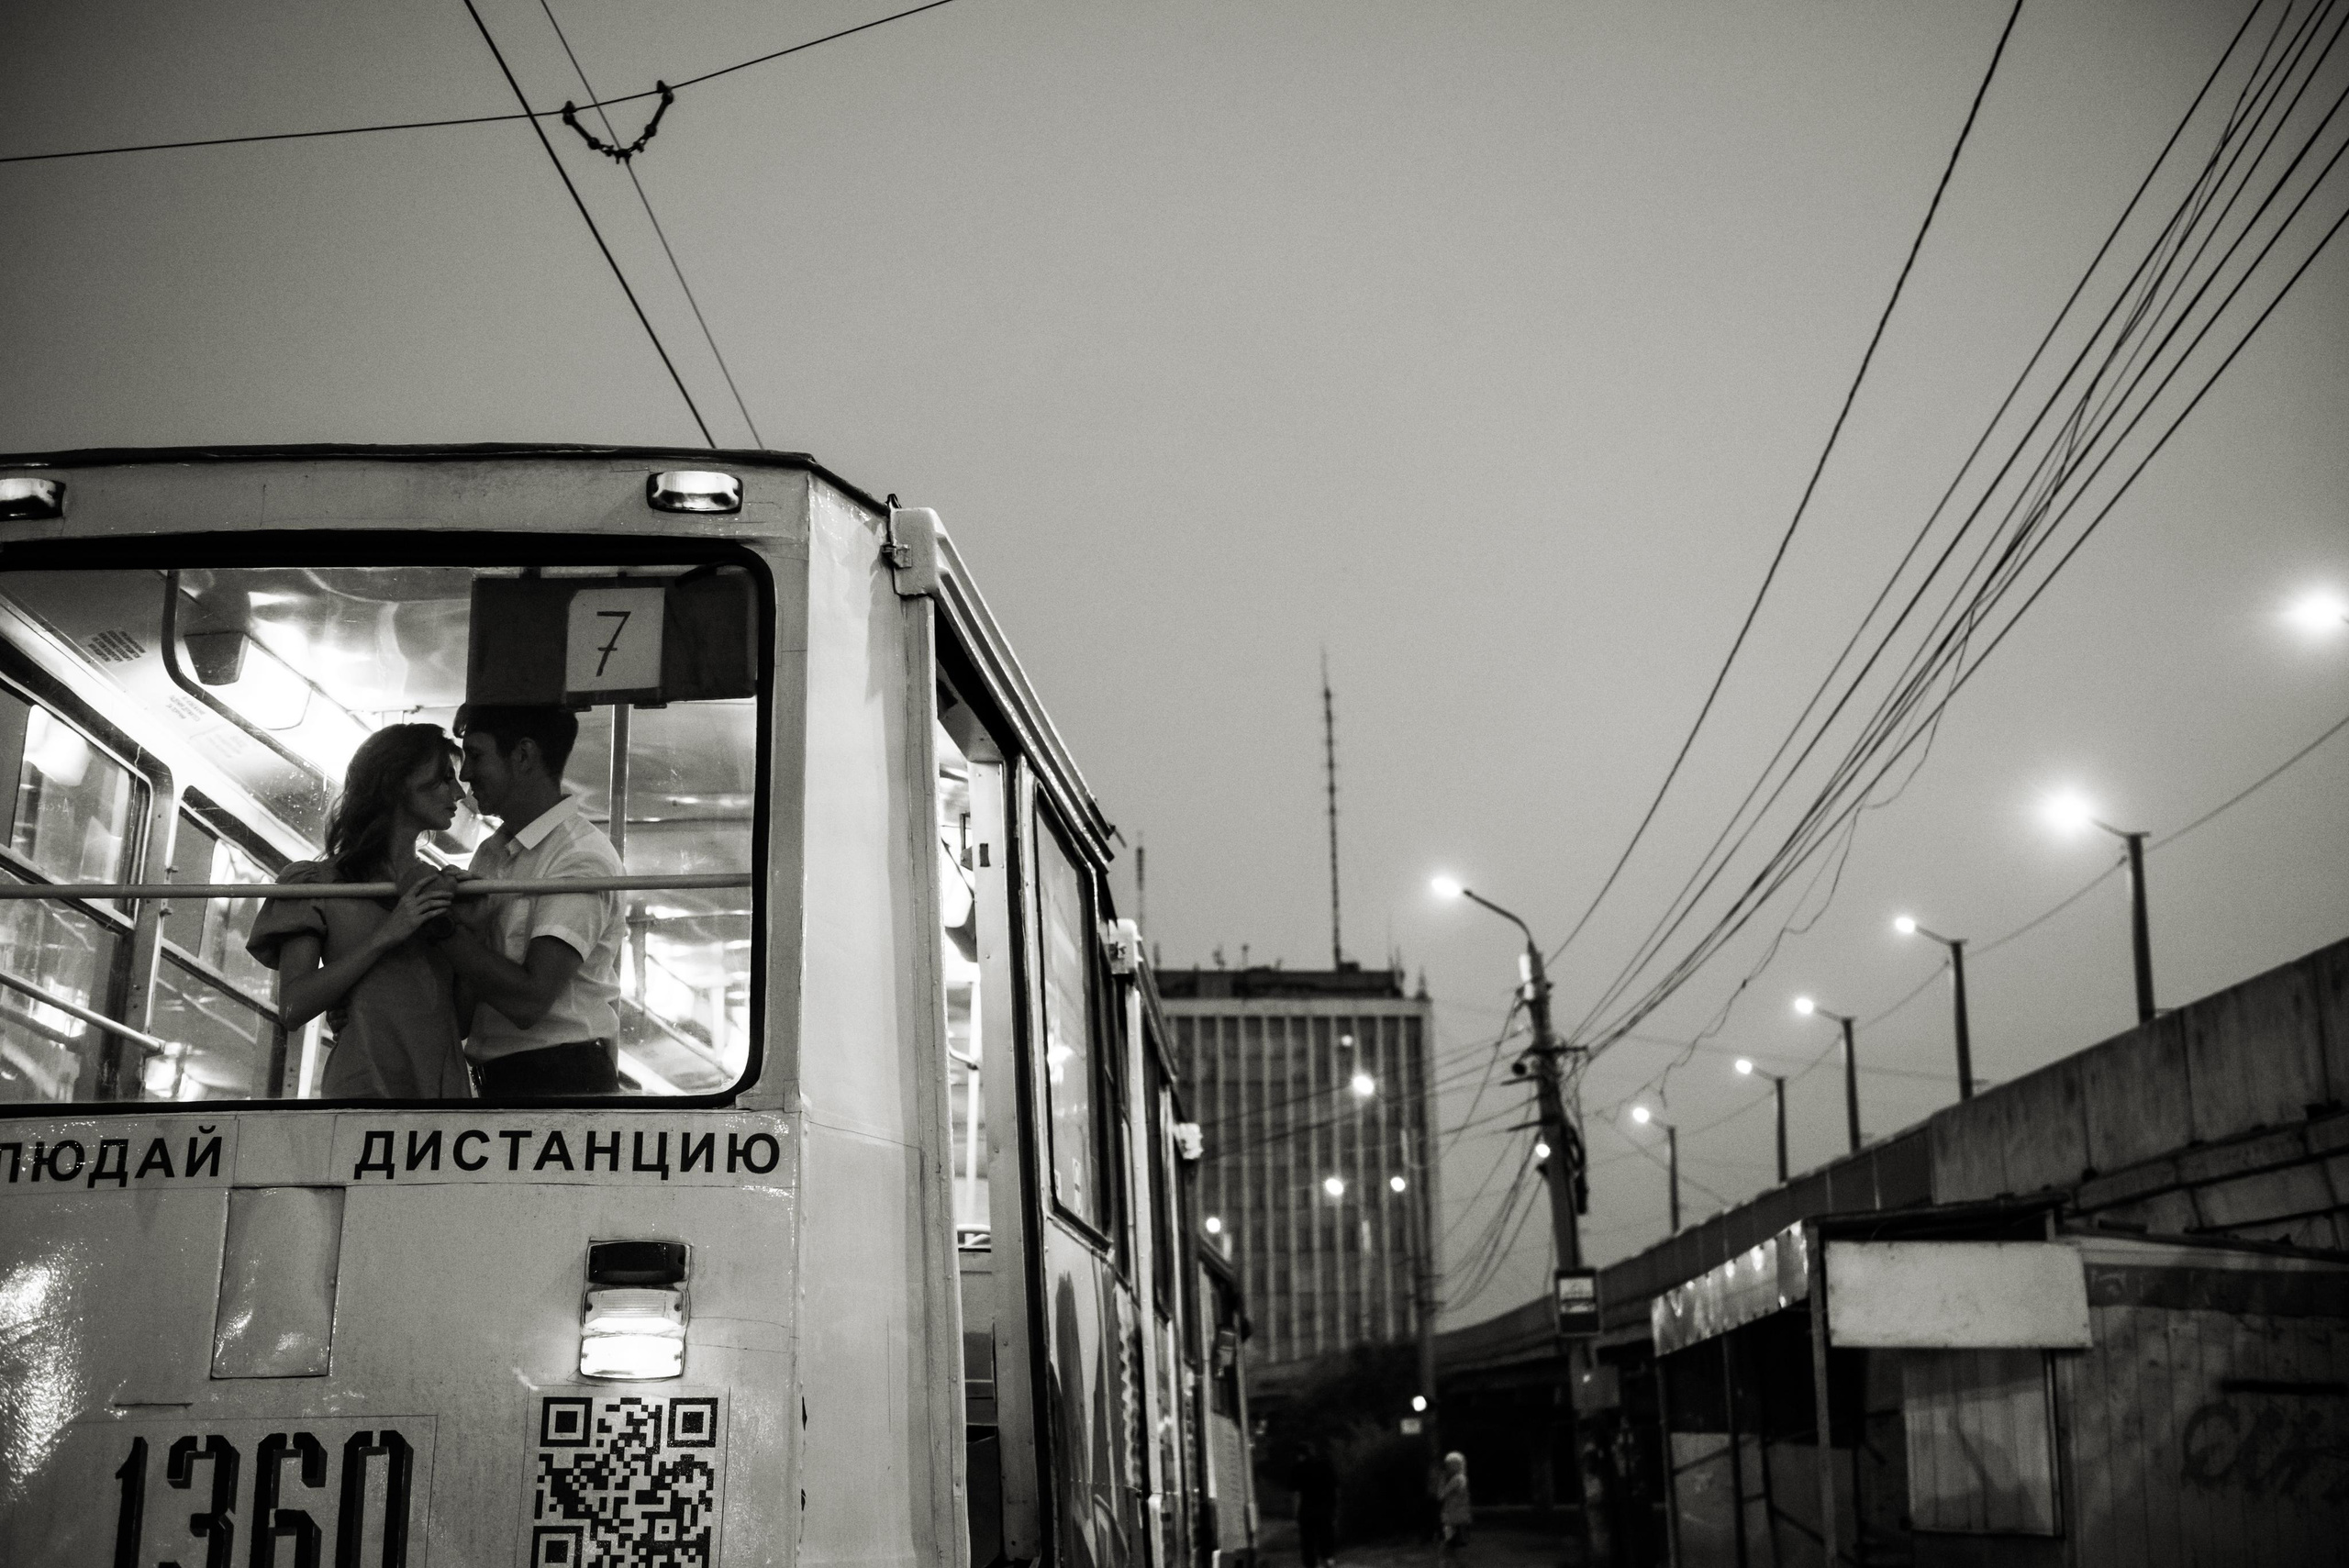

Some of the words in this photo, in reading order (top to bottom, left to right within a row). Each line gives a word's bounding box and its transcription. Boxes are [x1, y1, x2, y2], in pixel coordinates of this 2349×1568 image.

[596, 611, 631, 677] 7
[353, 1129, 781, 1180] ДИСТАНЦИЮ
[115, 1429, 414, 1568] 1360
